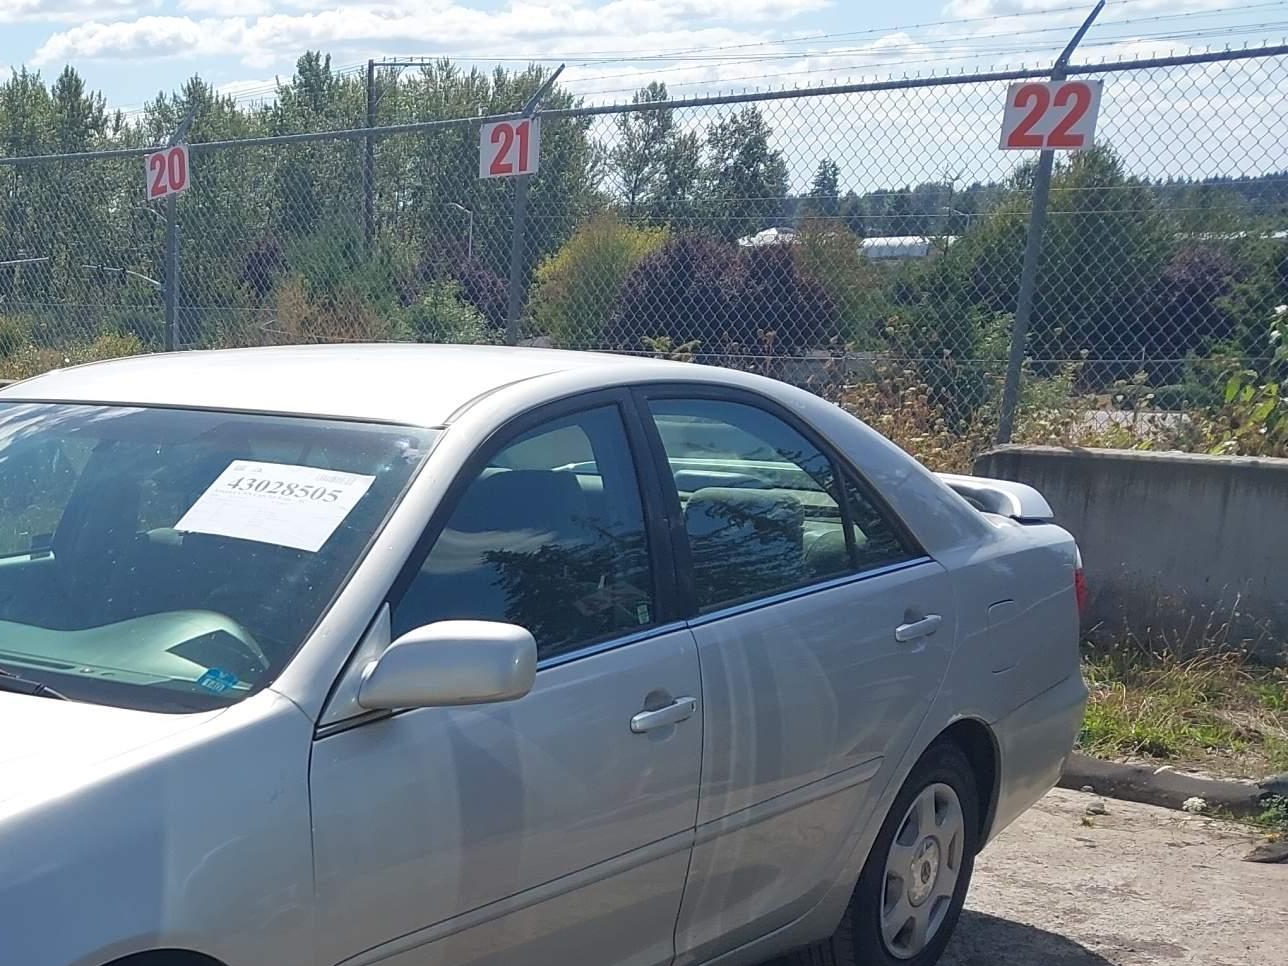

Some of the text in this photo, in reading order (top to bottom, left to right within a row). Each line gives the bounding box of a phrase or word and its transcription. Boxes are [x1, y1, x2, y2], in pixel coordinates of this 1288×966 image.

[1007, 83, 1092, 147] 22
[150, 147, 186, 197] 20
[489, 123, 529, 175] 21
[227, 476, 343, 503] 43028505
